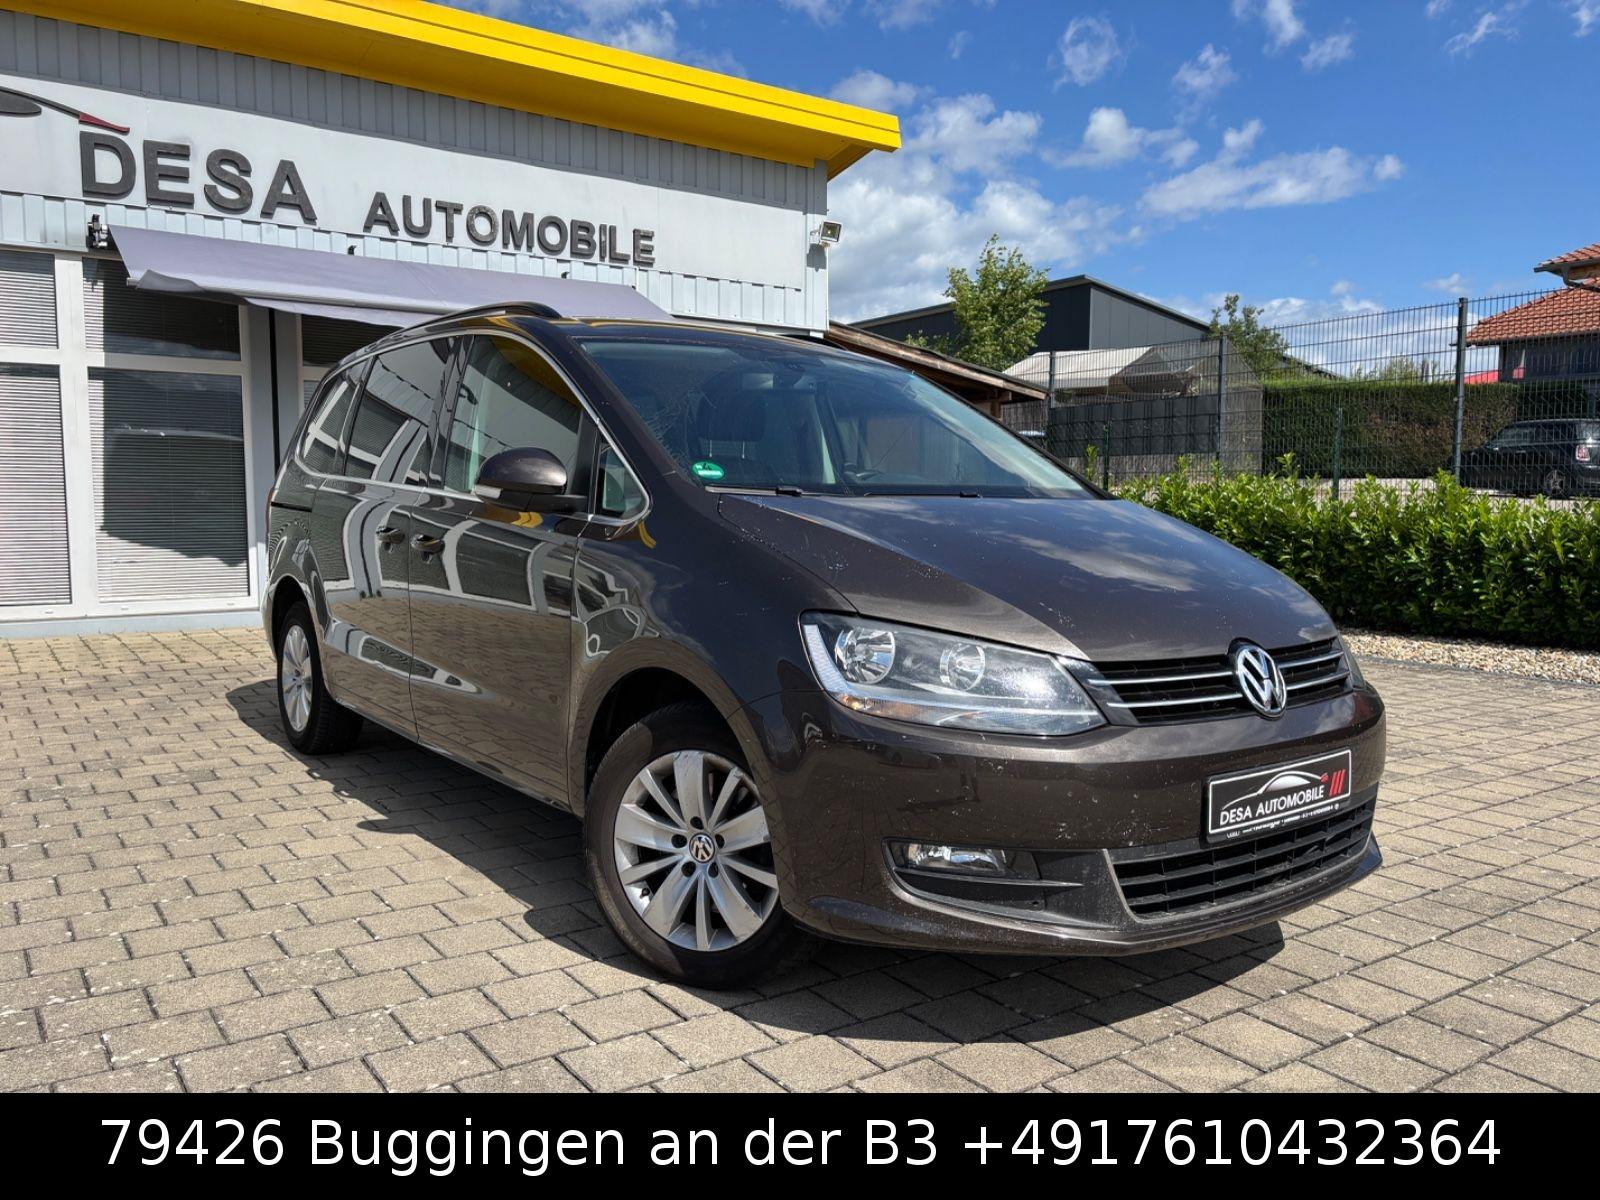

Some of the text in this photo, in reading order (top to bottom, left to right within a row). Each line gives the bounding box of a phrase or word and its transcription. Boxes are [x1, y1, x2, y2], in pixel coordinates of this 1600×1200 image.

[80, 130, 656, 267] DESA AUTOMOBILE
[1237, 644, 1286, 713] VW
[1219, 805, 1253, 826] DESA
[1256, 784, 1326, 817] AUTOMOBILE
